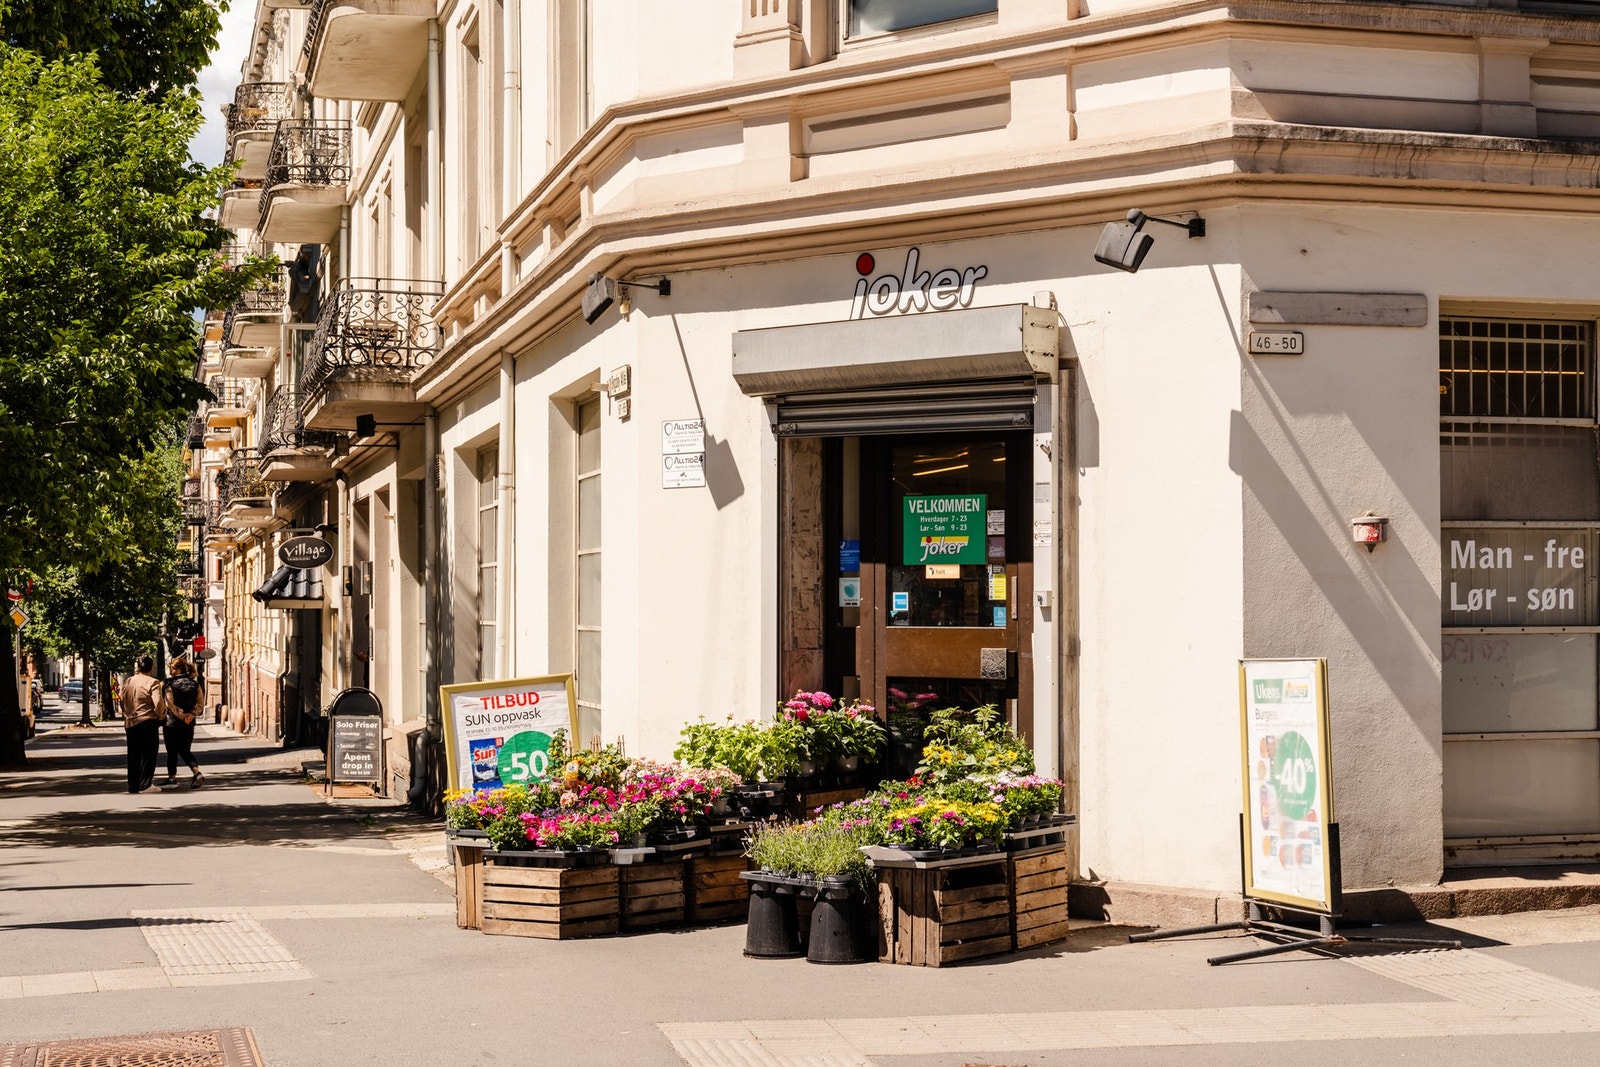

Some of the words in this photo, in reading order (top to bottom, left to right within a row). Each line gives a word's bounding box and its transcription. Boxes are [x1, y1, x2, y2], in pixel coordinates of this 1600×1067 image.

[849, 247, 988, 320] joker
[1256, 336, 1271, 349] 46
[1282, 337, 1297, 350] 50
[908, 498, 980, 514] VELKOMMEN
[920, 516, 949, 524] Hverdager
[284, 543, 326, 559] Village
[920, 536, 966, 562] joker
[1451, 540, 1512, 569] Man
[1544, 539, 1585, 569] fre
[1450, 582, 1497, 612] Lør
[1527, 587, 1574, 612] søn
[480, 691, 540, 710] TILBUD
[465, 713, 491, 727] SUN
[493, 707, 542, 725] oppvask
[473, 749, 497, 762] Sun
[341, 762, 362, 770] drop
